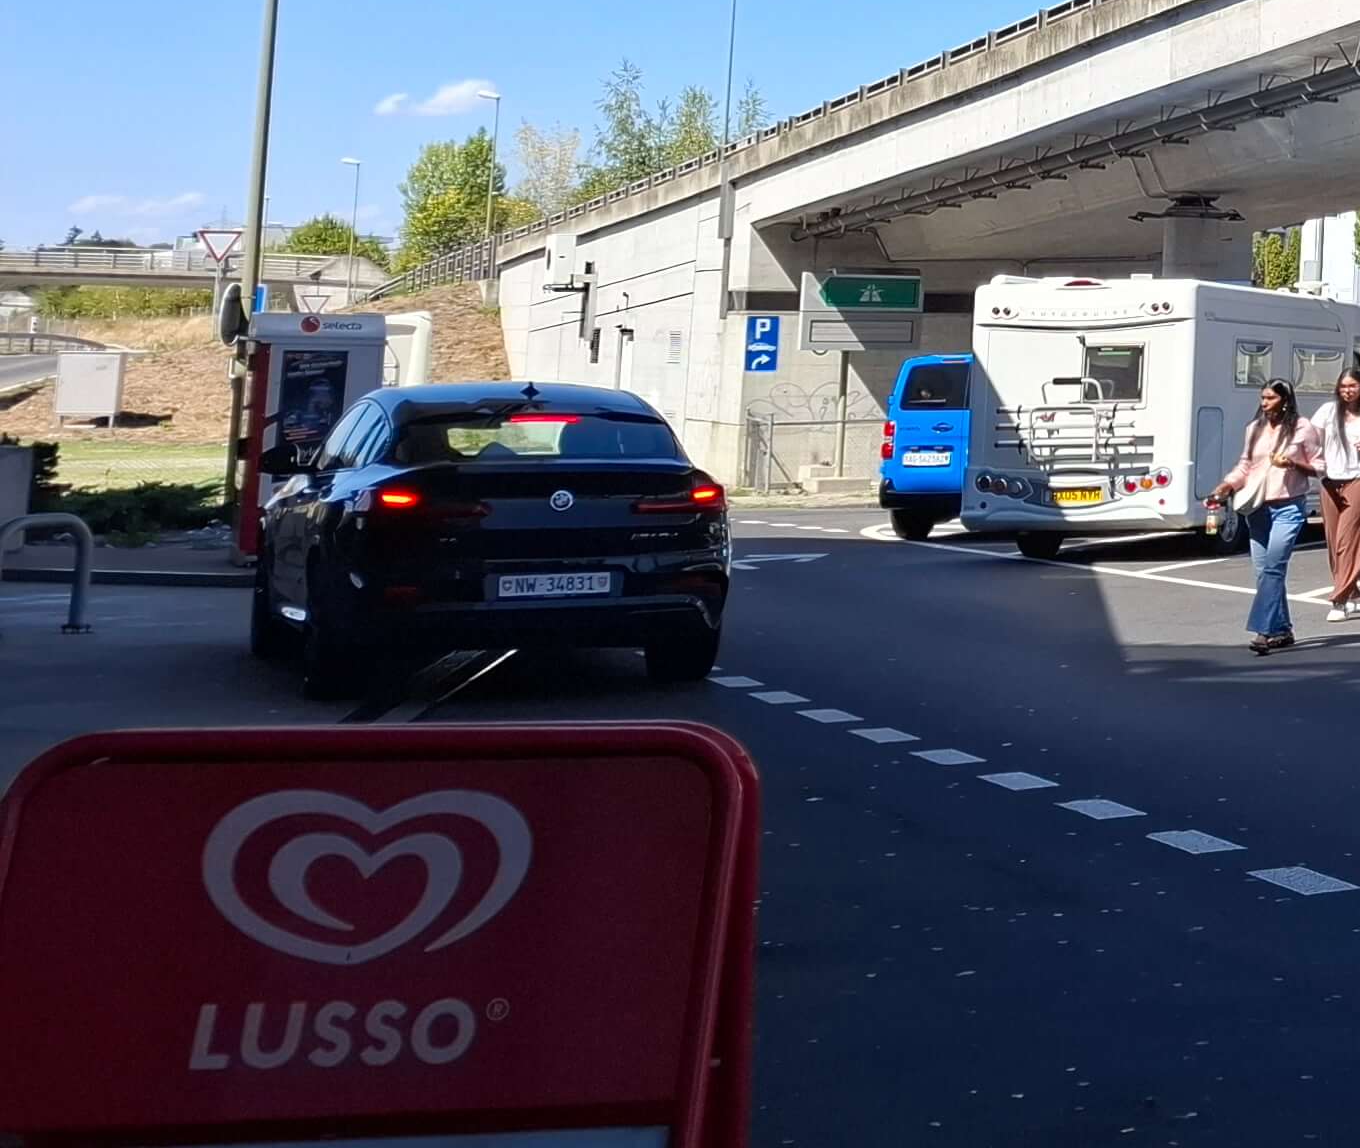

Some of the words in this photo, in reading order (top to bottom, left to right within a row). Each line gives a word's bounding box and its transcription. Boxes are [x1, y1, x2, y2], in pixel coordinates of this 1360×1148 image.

[322, 321, 362, 331] selecta
[755, 318, 771, 340] P
[188, 997, 479, 1073] LUSSO
